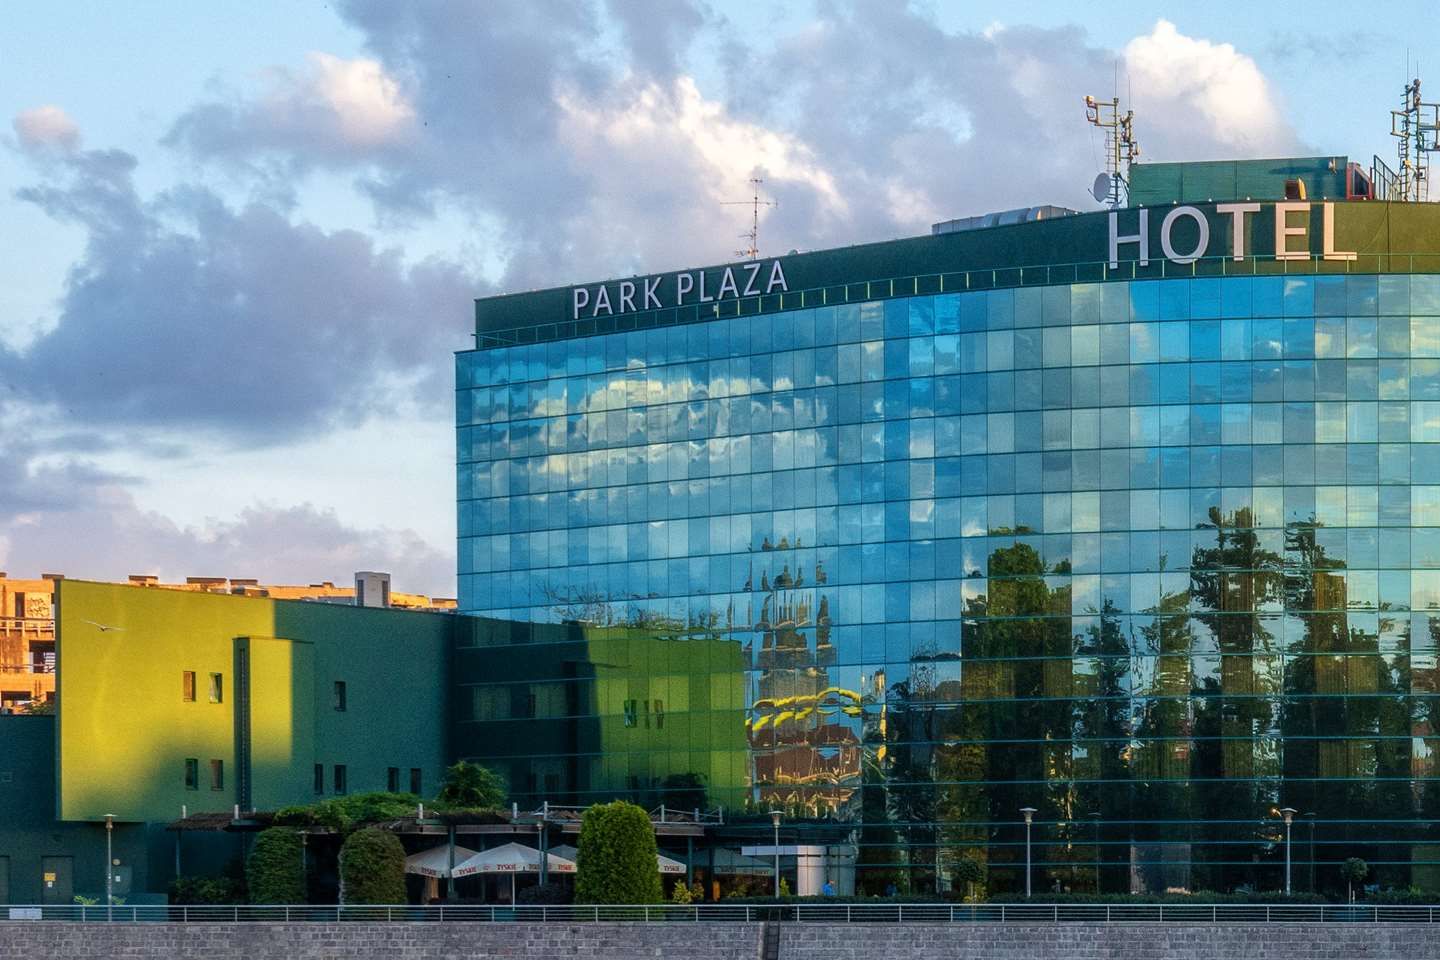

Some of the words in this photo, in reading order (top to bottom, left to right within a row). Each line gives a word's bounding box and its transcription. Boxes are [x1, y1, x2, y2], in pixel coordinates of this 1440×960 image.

[1108, 202, 1358, 269] HOTEL
[574, 276, 664, 319] PARK
[677, 260, 788, 305] PLAZA
